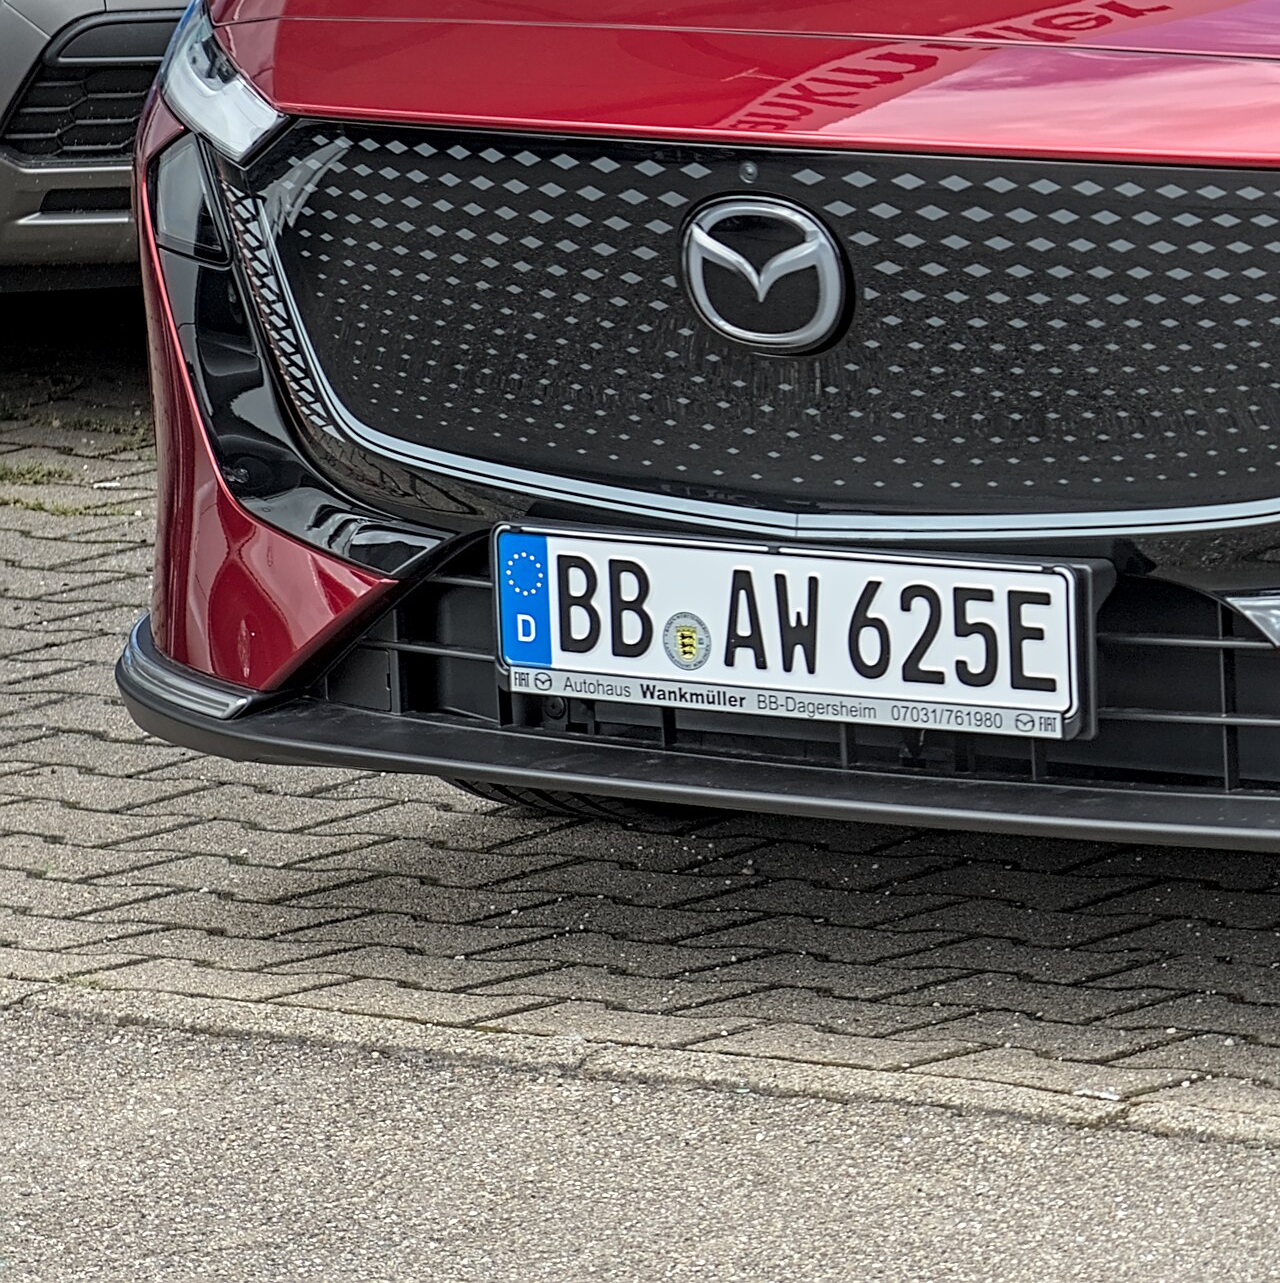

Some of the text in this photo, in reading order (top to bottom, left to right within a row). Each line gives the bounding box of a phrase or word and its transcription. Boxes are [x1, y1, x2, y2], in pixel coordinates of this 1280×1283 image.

[517, 614, 536, 642] D
[556, 554, 653, 658] BB
[724, 569, 819, 675] AW
[848, 580, 1058, 692] 625E
[514, 671, 1057, 733] FIAT Autohaus Wankmüller BB-Dagersheim 07031/761980 FIAT
